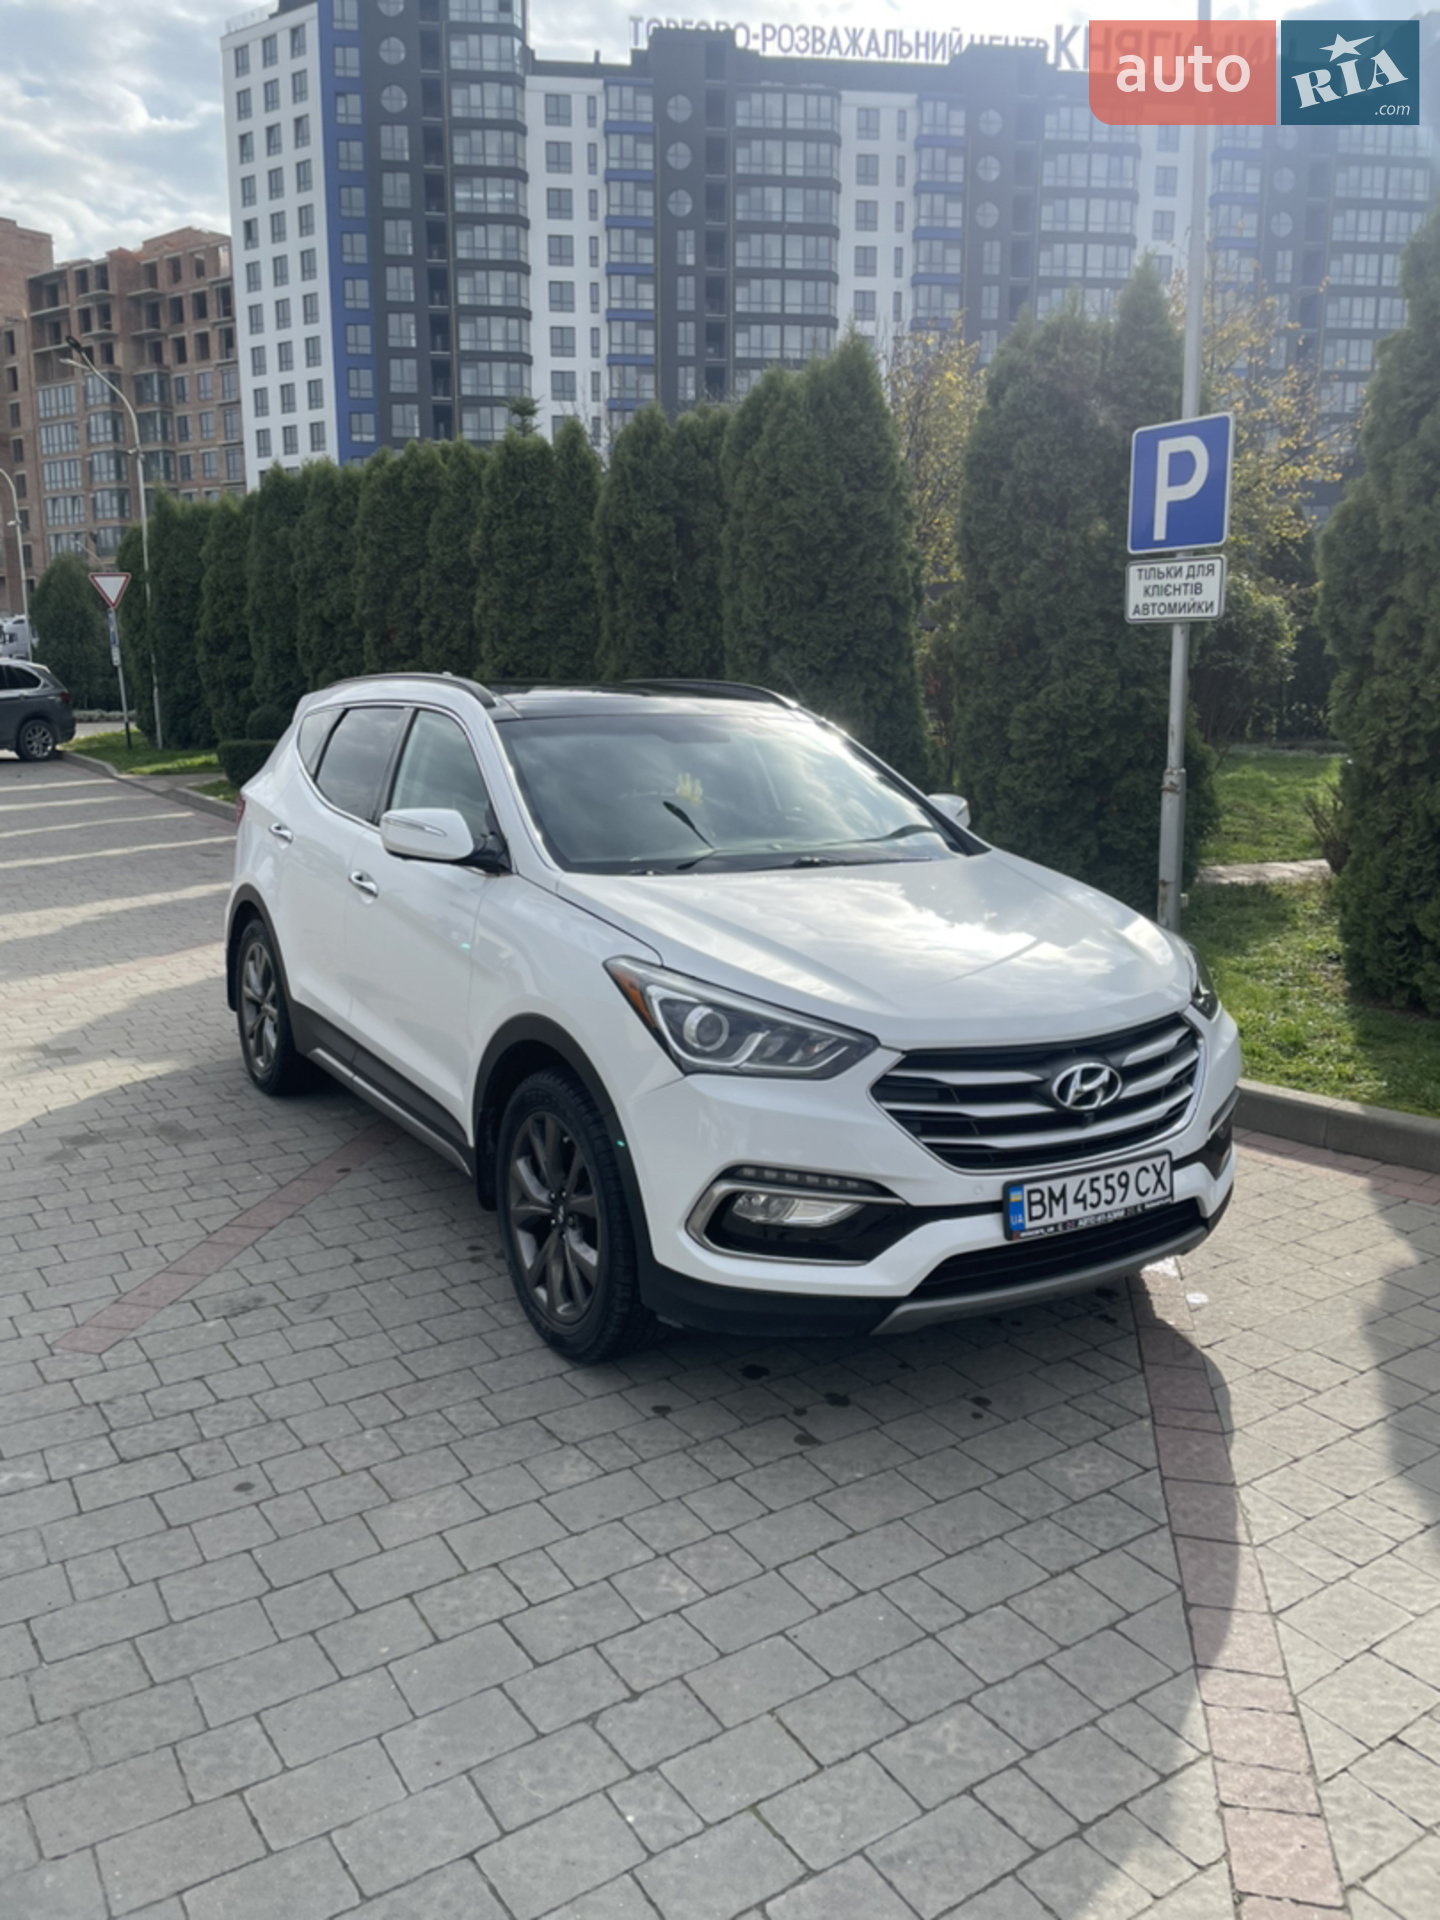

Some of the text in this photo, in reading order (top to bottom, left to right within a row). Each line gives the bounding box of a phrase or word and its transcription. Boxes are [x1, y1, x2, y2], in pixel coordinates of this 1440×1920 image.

[1153, 435, 1209, 541] P
[1136, 563, 1215, 580] ТІЛЬКИ ДЛЯ
[1143, 582, 1203, 598] КЛІЄНТІВ
[1132, 597, 1215, 616] АВТОМИЙКИ
[1073, 1170, 1130, 1211] 4559
